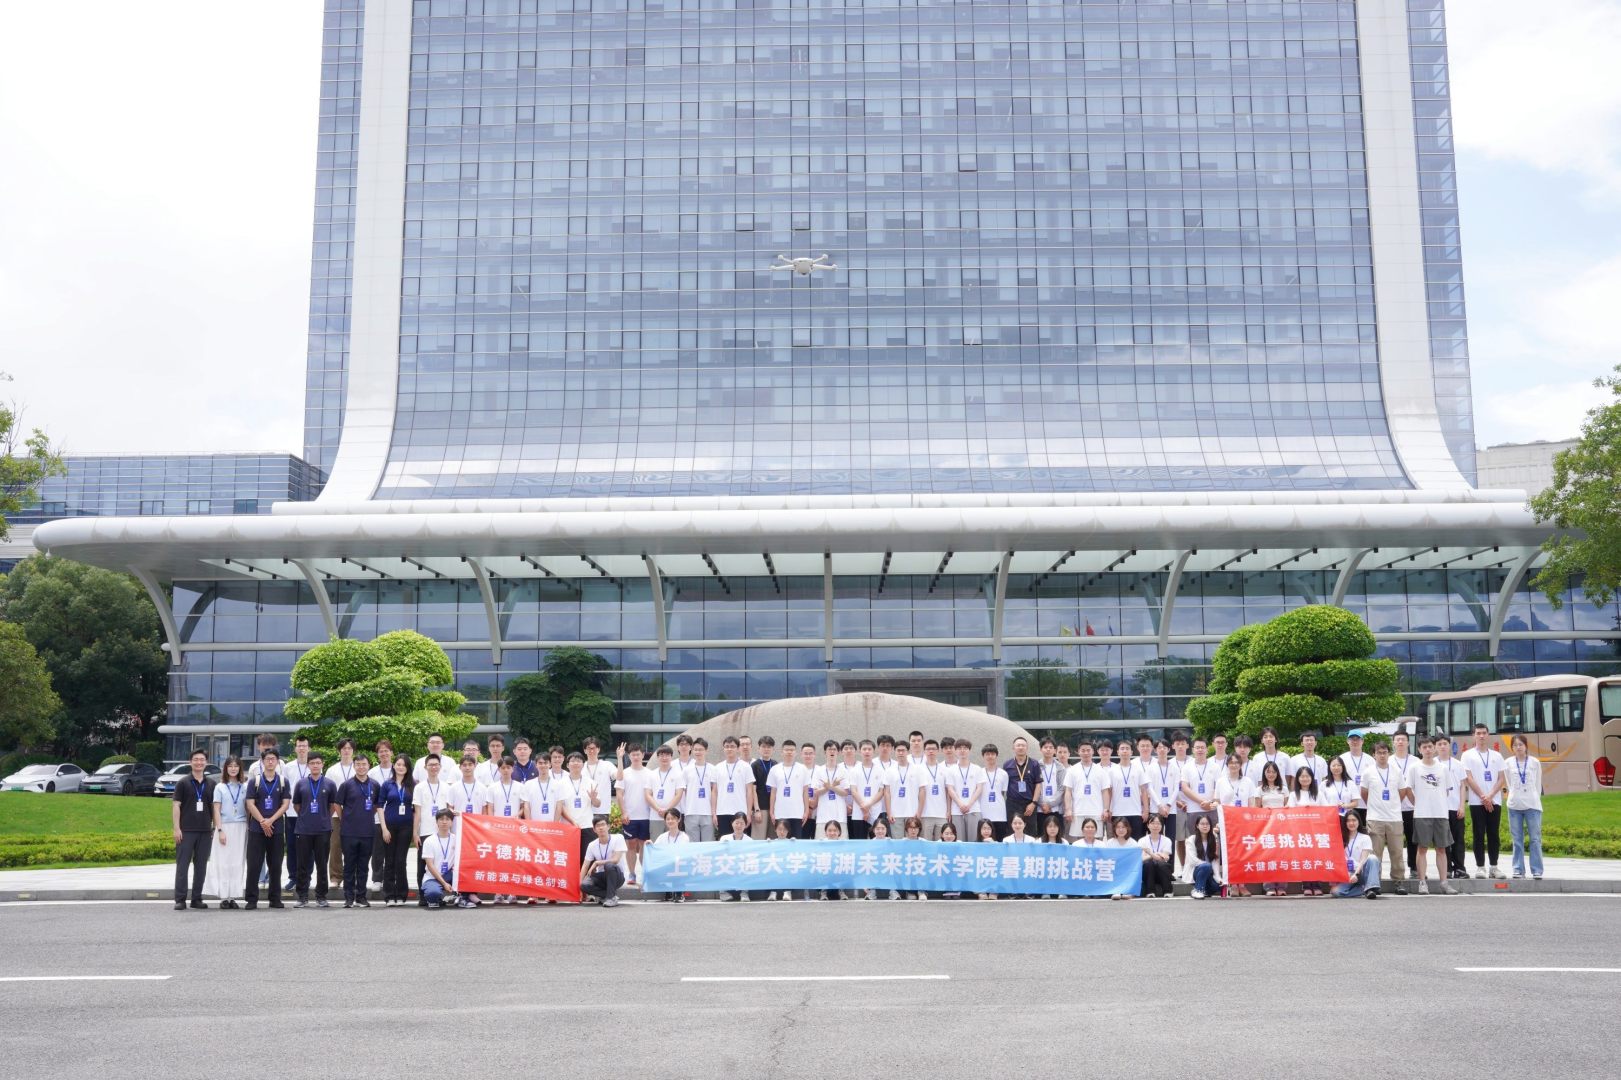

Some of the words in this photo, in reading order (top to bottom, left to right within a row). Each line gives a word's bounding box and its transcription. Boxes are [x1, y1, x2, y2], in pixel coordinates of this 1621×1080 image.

[1243, 834, 1331, 850] 宁德挑战营
[476, 843, 568, 867] 宁德挑战营
[667, 853, 1116, 882] 上海交通大学溥渊未来技术学院暑期挑战营
[1245, 860, 1335, 872] 大健康与生态产业
[475, 871, 568, 888] 新能源与绿色制造
